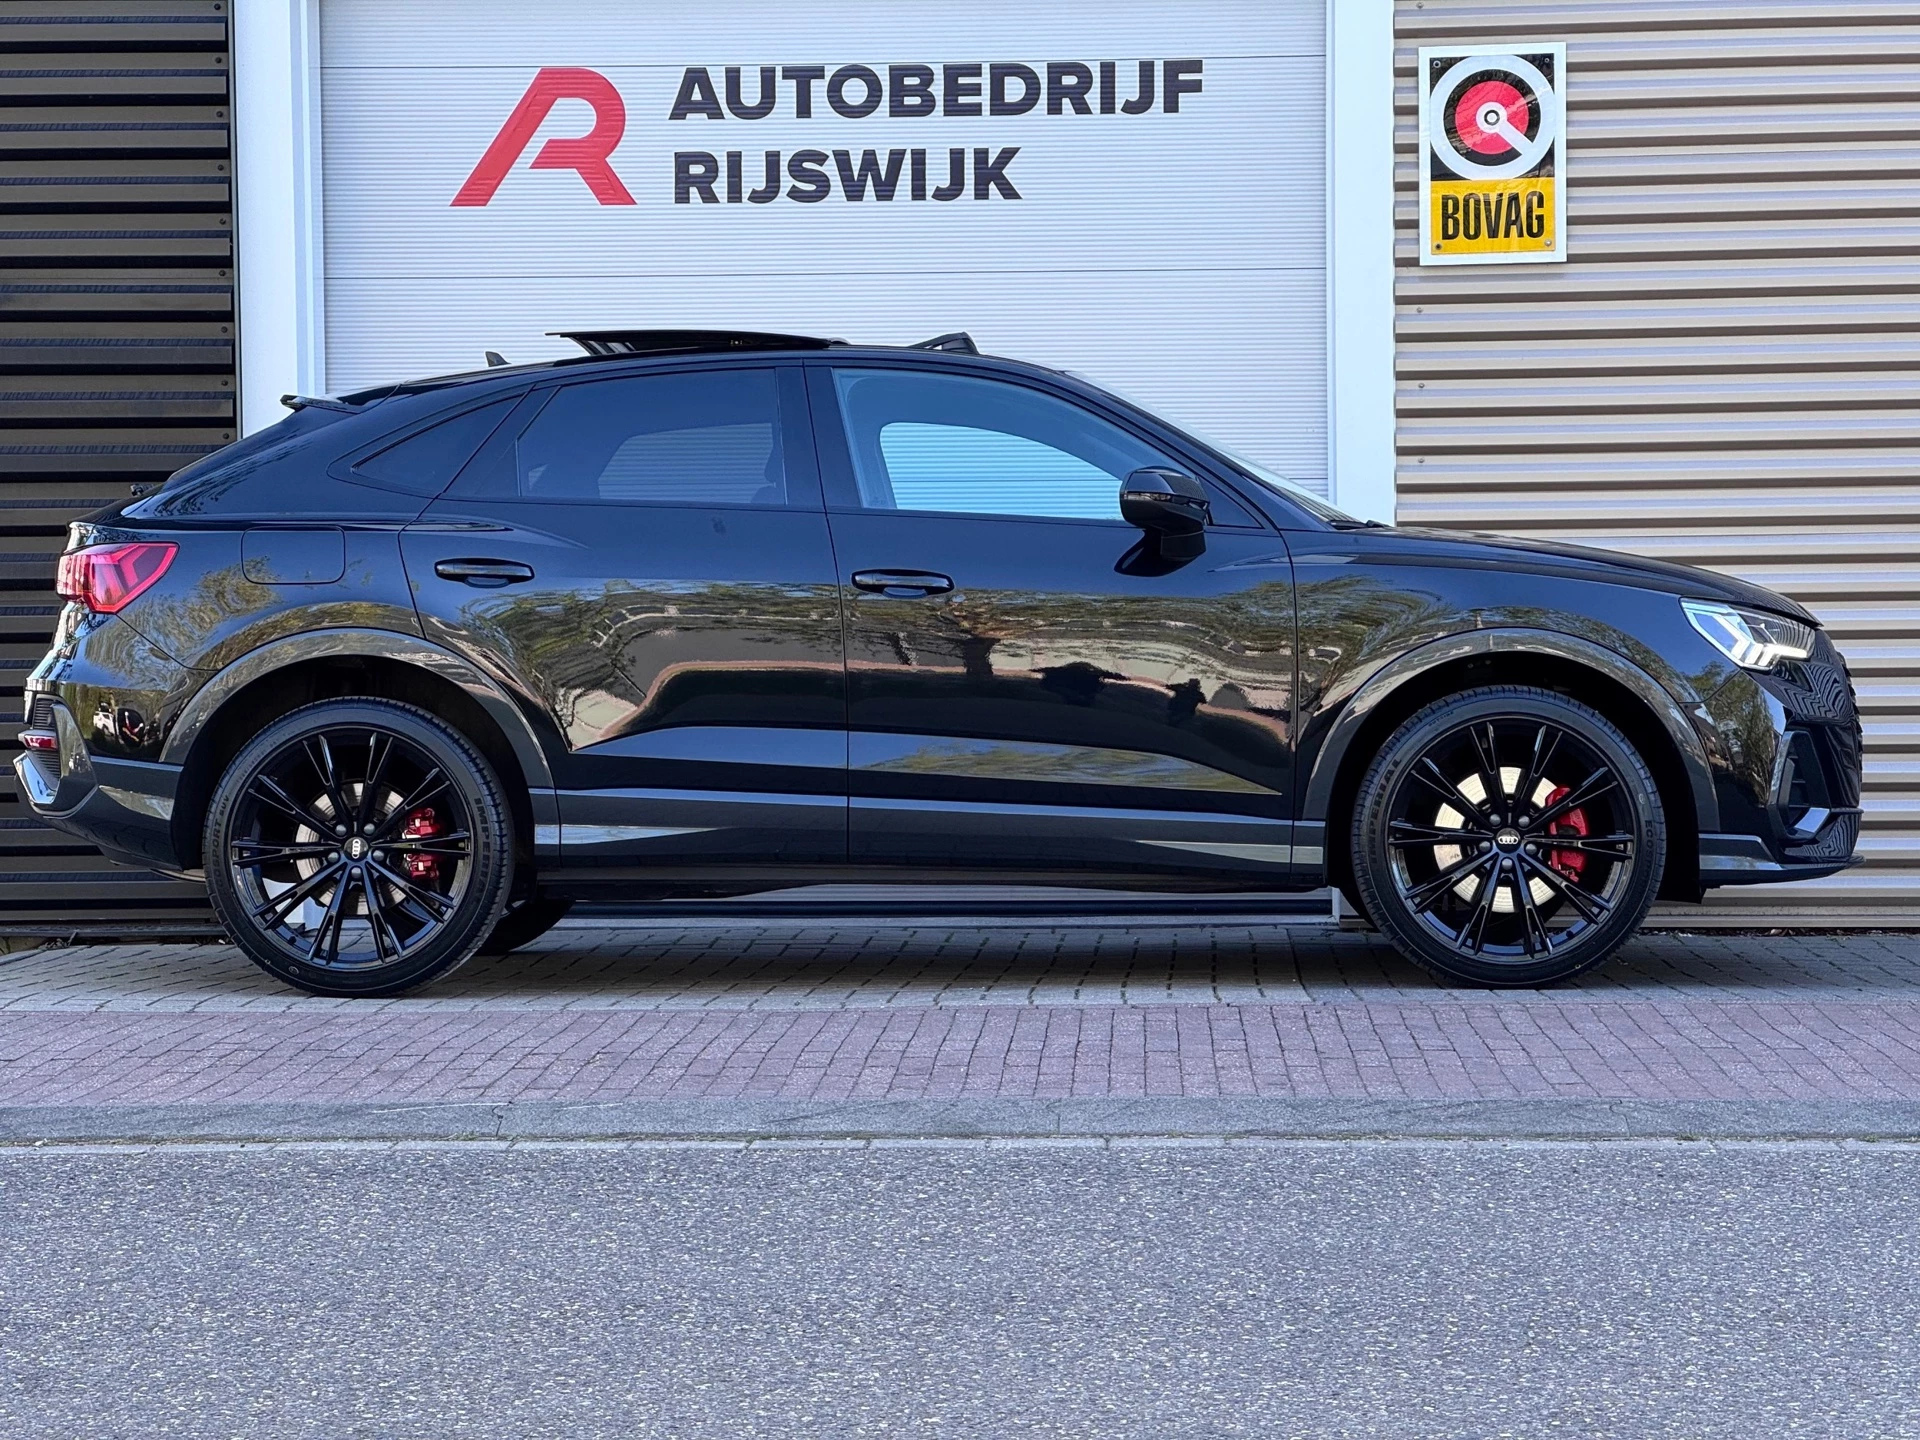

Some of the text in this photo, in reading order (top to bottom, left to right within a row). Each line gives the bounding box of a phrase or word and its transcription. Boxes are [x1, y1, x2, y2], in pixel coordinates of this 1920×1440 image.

[669, 60, 1202, 120] AUTOBEDRIJF
[675, 147, 1022, 204] RIJSWIJK
[1442, 191, 1545, 240] BOVAG
[1368, 757, 1402, 864] IMPERIAL
[211, 818, 226, 896] COSPORT
